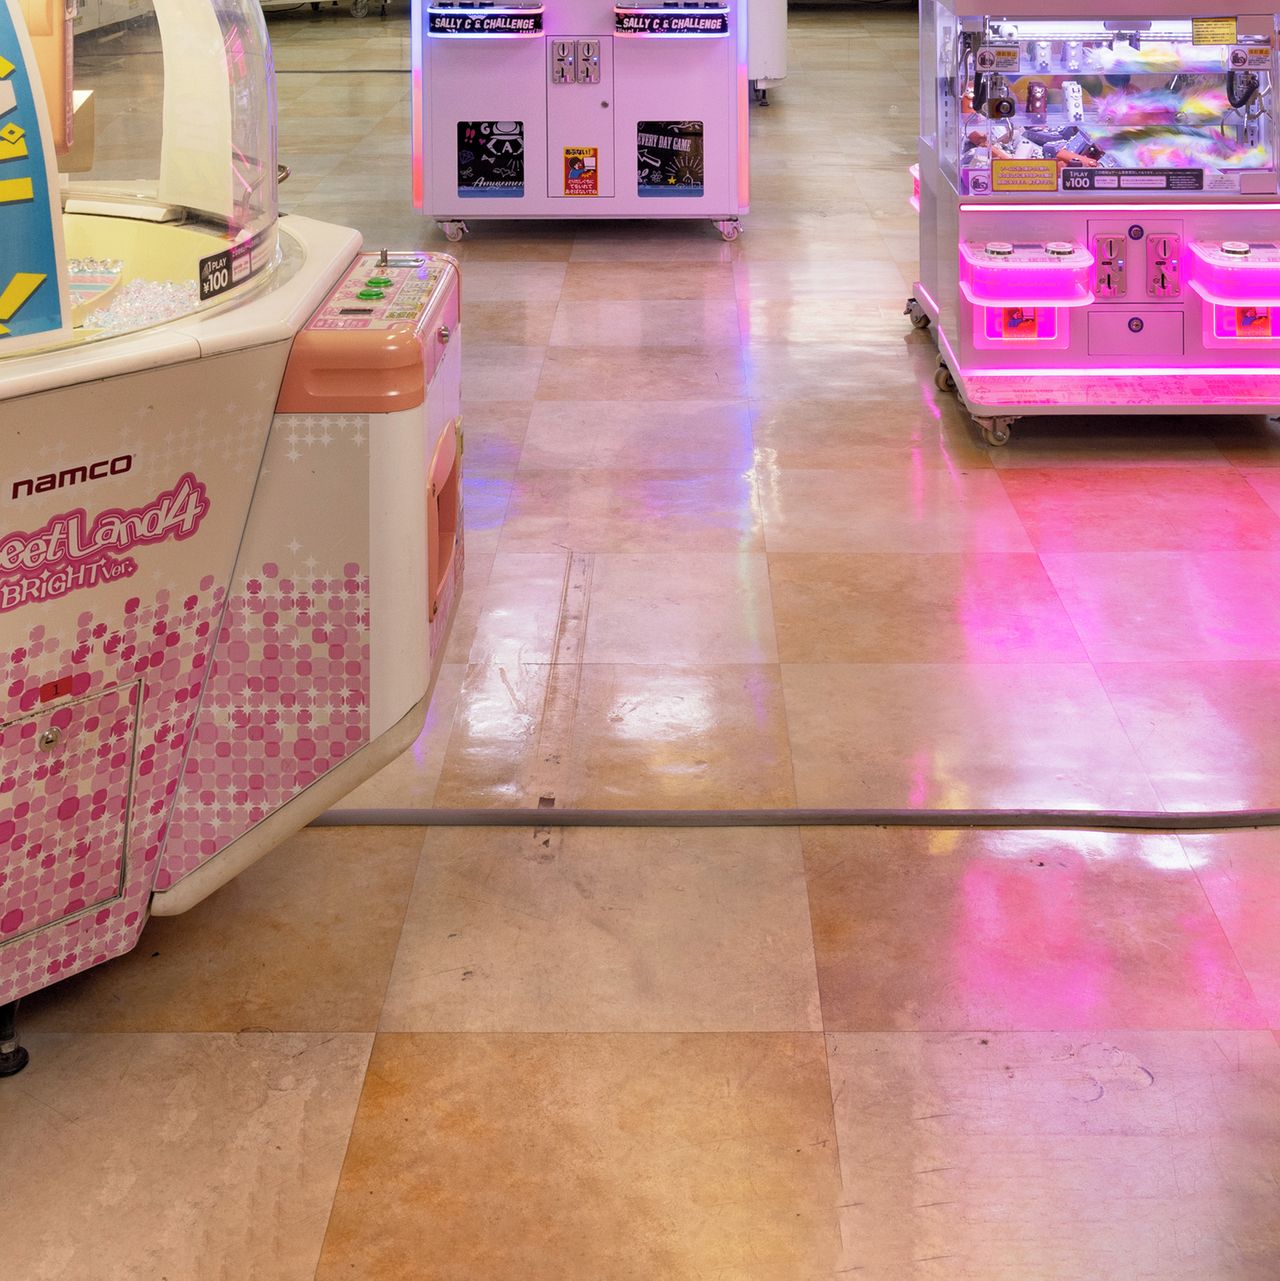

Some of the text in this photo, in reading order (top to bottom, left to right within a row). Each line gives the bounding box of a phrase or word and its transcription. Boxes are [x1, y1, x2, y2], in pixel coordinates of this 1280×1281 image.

[434, 18, 462, 29] SALLY
[464, 18, 472, 29] C
[483, 18, 535, 29] CHALLENGE
[623, 18, 651, 29] SALLY
[653, 18, 661, 29] C
[672, 18, 723, 29] CHALLENGE
[657, 134, 672, 150] DAY
[672, 135, 692, 152] GAME
[1065, 177, 1090, 188] ¥100
[202, 269, 229, 294] ¥100
[11, 454, 133, 501] namco
